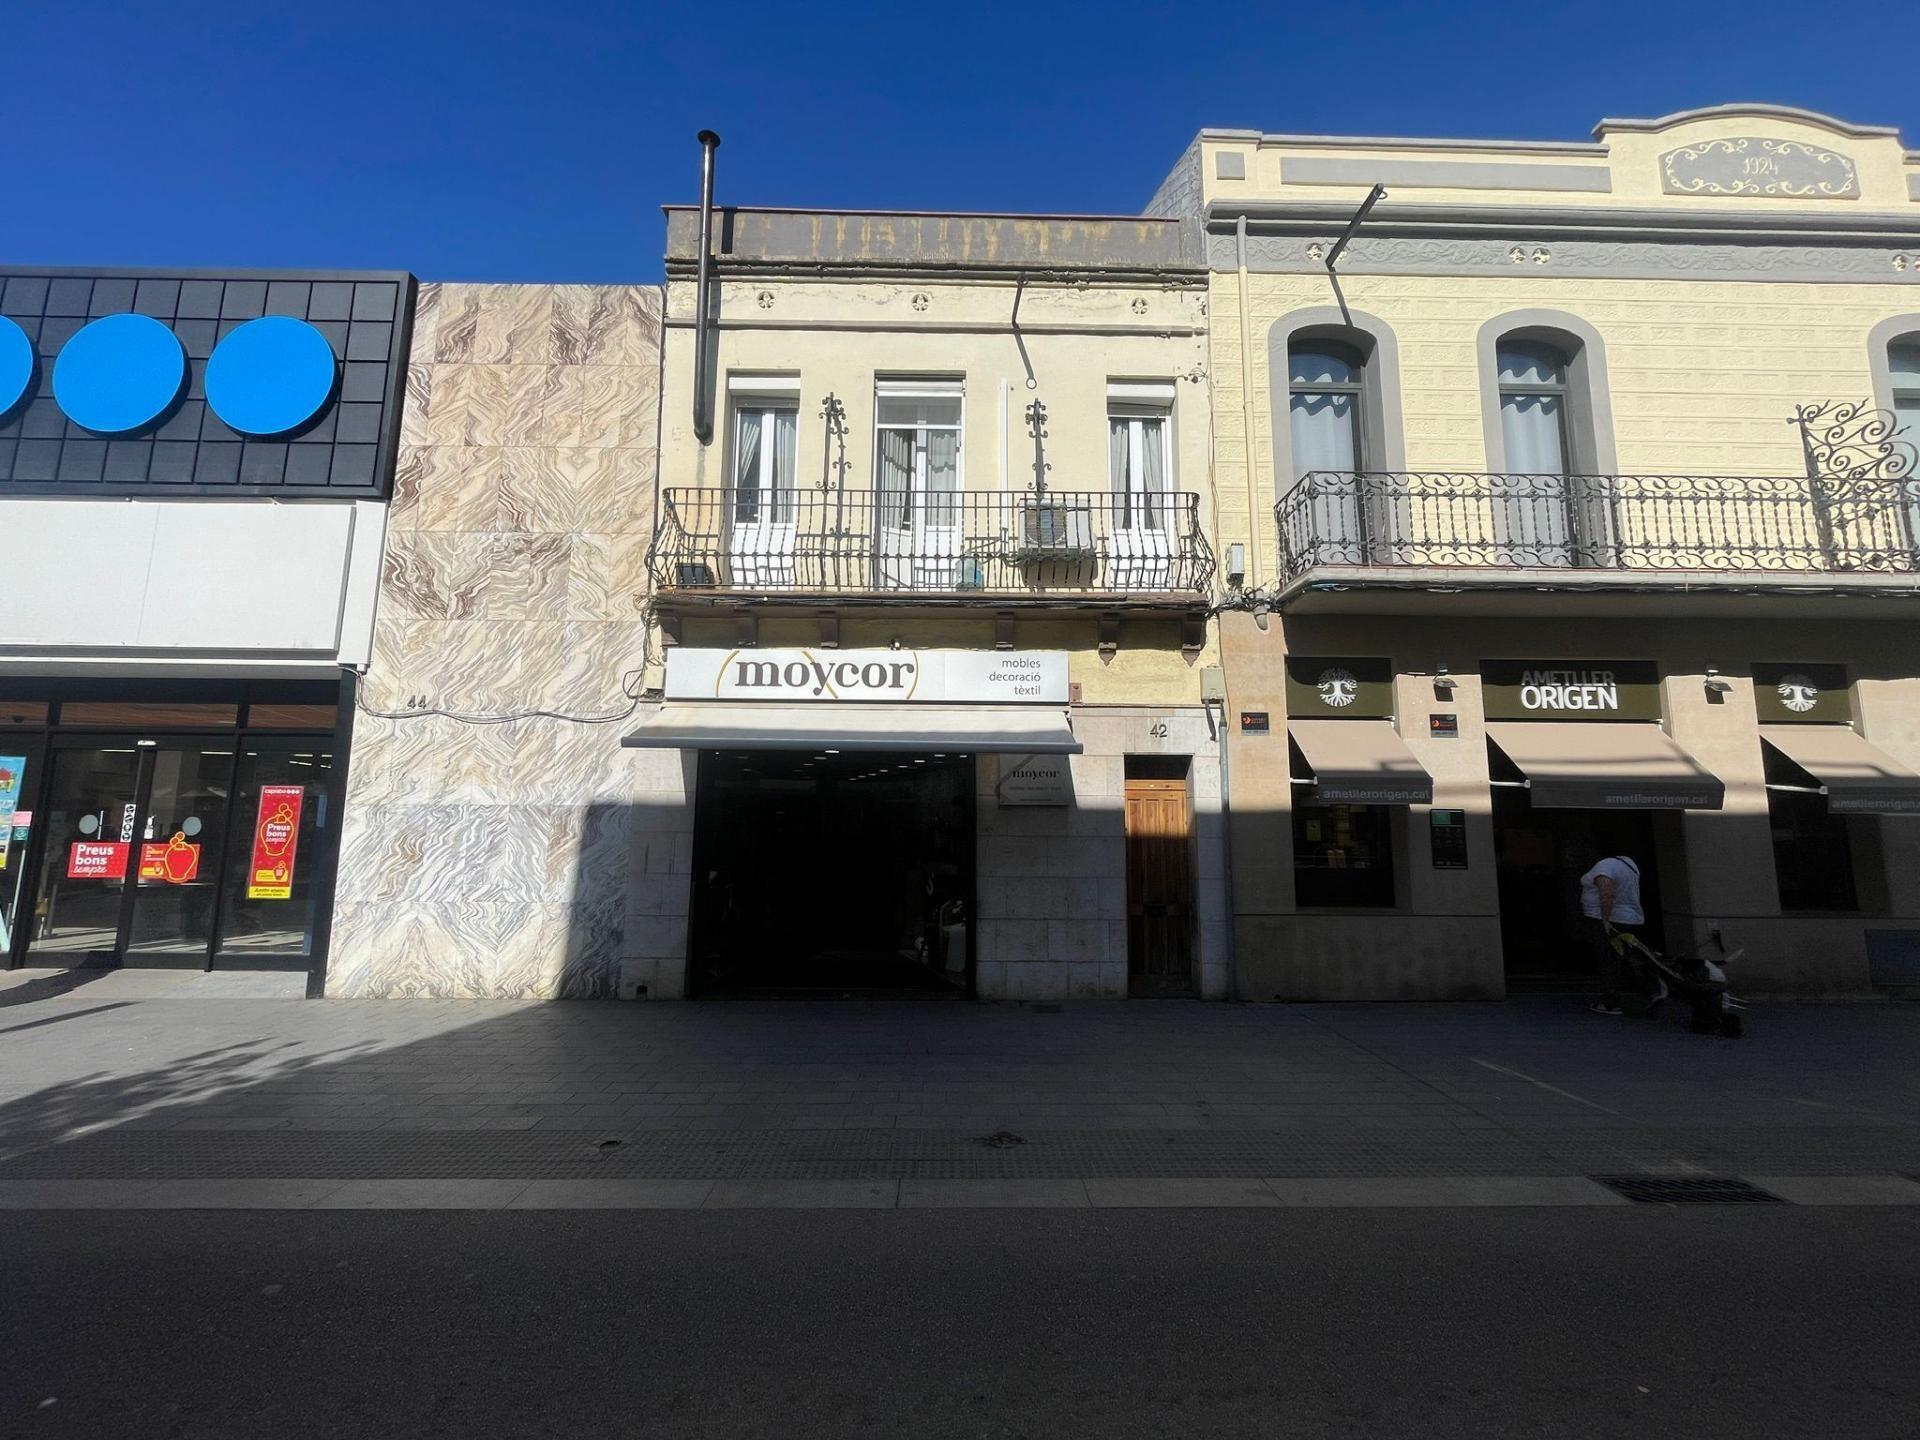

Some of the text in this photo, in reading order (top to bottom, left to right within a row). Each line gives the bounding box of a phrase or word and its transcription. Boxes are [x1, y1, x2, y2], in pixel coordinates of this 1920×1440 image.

[1742, 156, 1779, 176] 1924
[1001, 658, 1041, 669] mobles
[734, 660, 915, 696] moycor
[988, 671, 1041, 682] decoració
[1520, 669, 1617, 686] AMETLLER
[1013, 685, 1041, 695] tèxtil
[1520, 686, 1619, 710] ORIGEN
[1149, 724, 1168, 738] 42
[1012, 770, 1060, 780] moycor
[267, 823, 291, 832] Preus
[77, 845, 115, 855] Preus
[75, 855, 107, 865] bons
